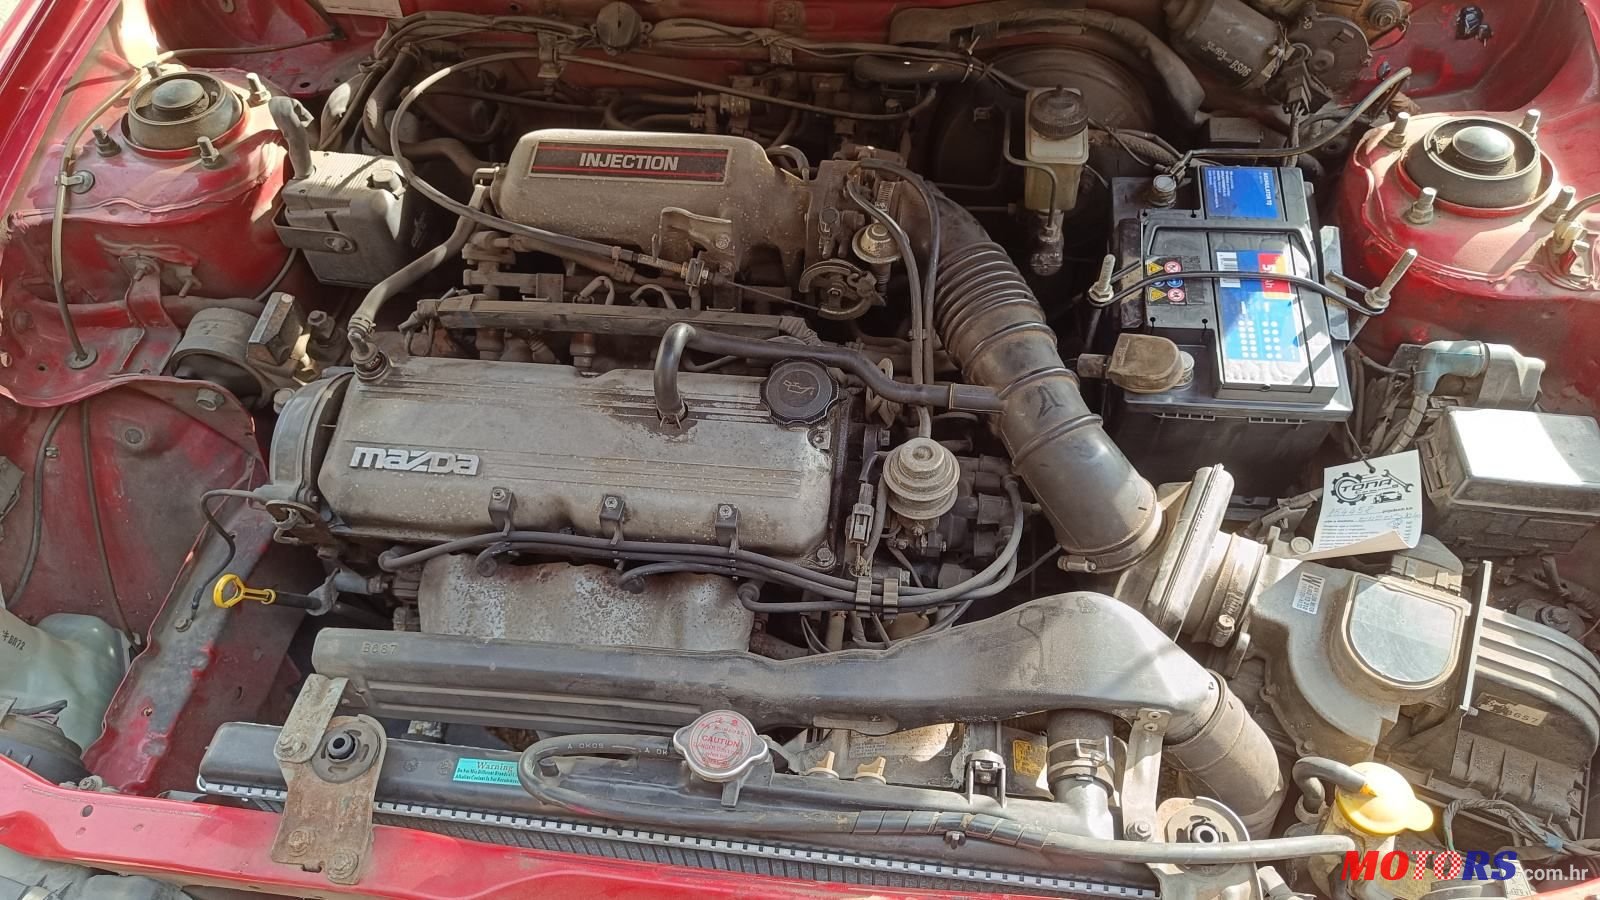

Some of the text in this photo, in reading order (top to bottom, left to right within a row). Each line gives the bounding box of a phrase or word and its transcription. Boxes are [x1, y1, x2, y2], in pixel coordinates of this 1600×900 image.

[579, 152, 679, 171] INJECTION
[702, 735, 740, 748] CAUTION
[477, 761, 514, 773] Warning
